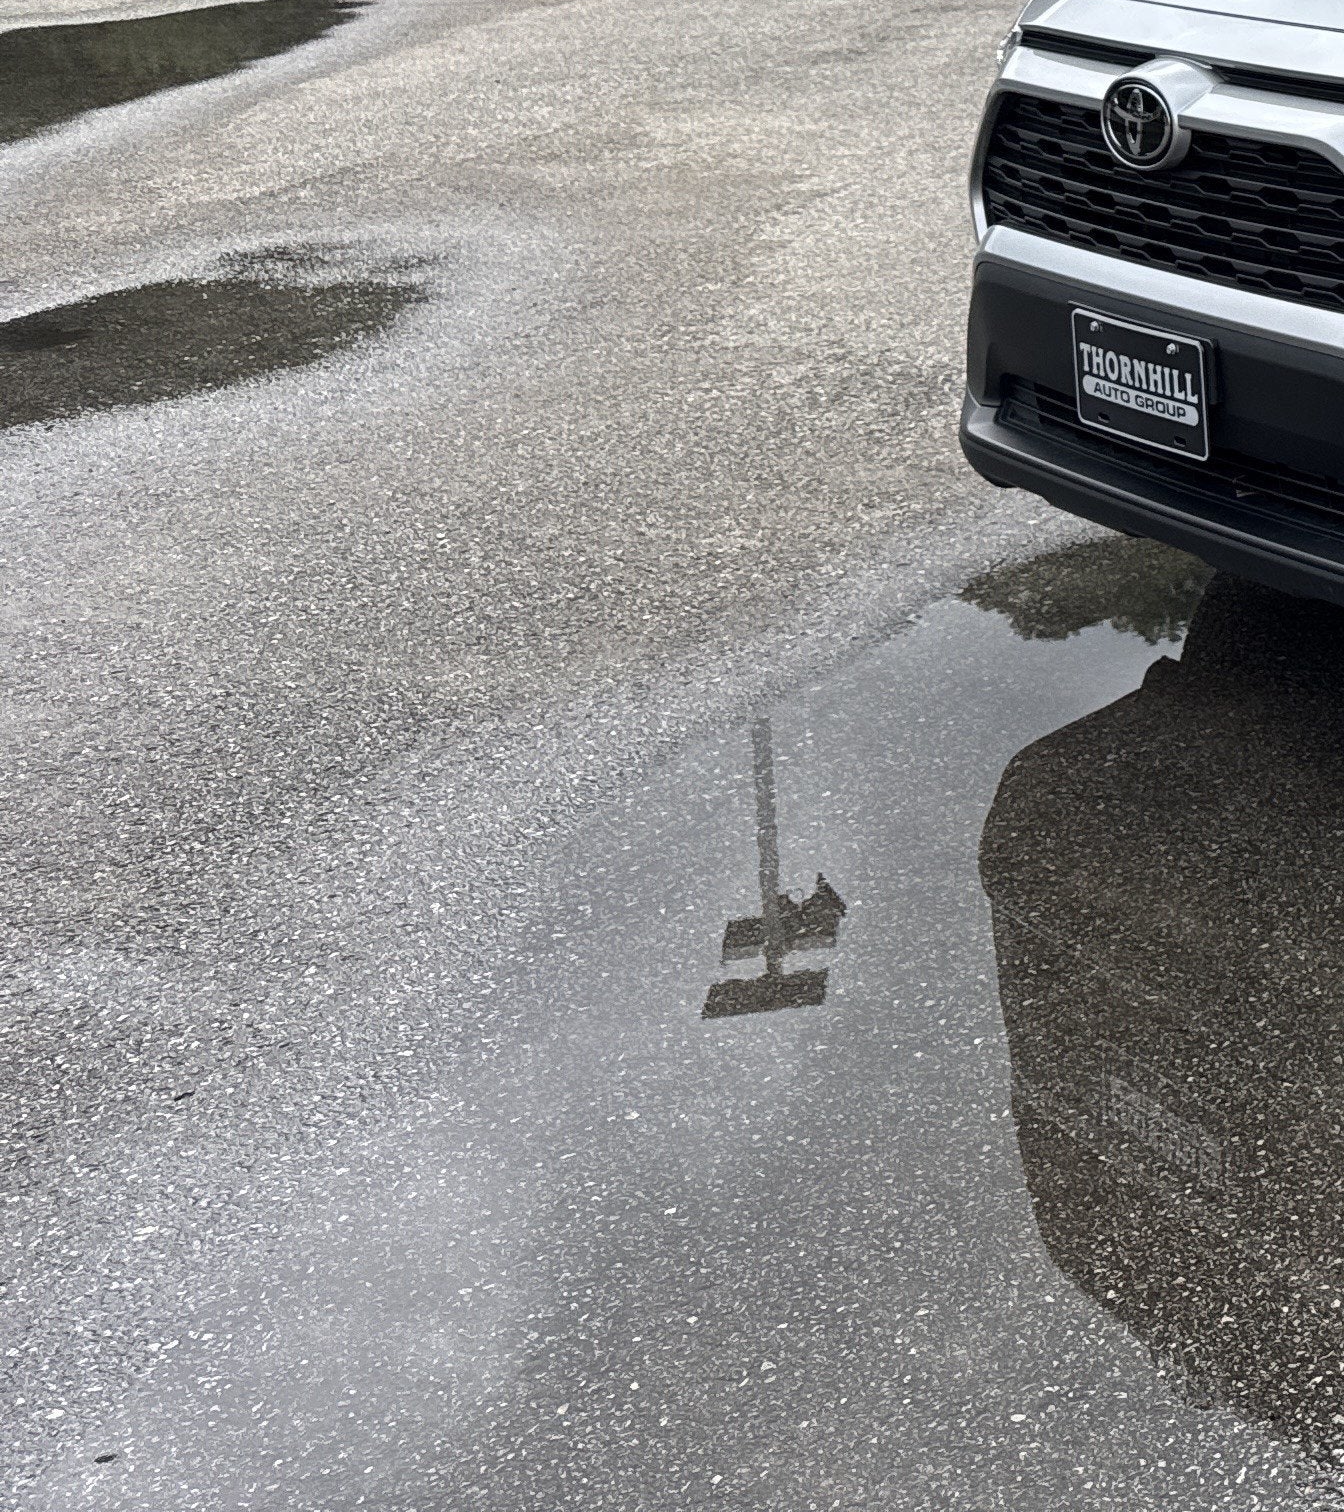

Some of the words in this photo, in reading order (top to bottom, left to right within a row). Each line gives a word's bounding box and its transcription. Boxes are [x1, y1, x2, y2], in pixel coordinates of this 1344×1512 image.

[1079, 342, 1198, 404] THORNHILL
[1093, 381, 1131, 404] AUTO
[1134, 394, 1187, 419] GROUP
